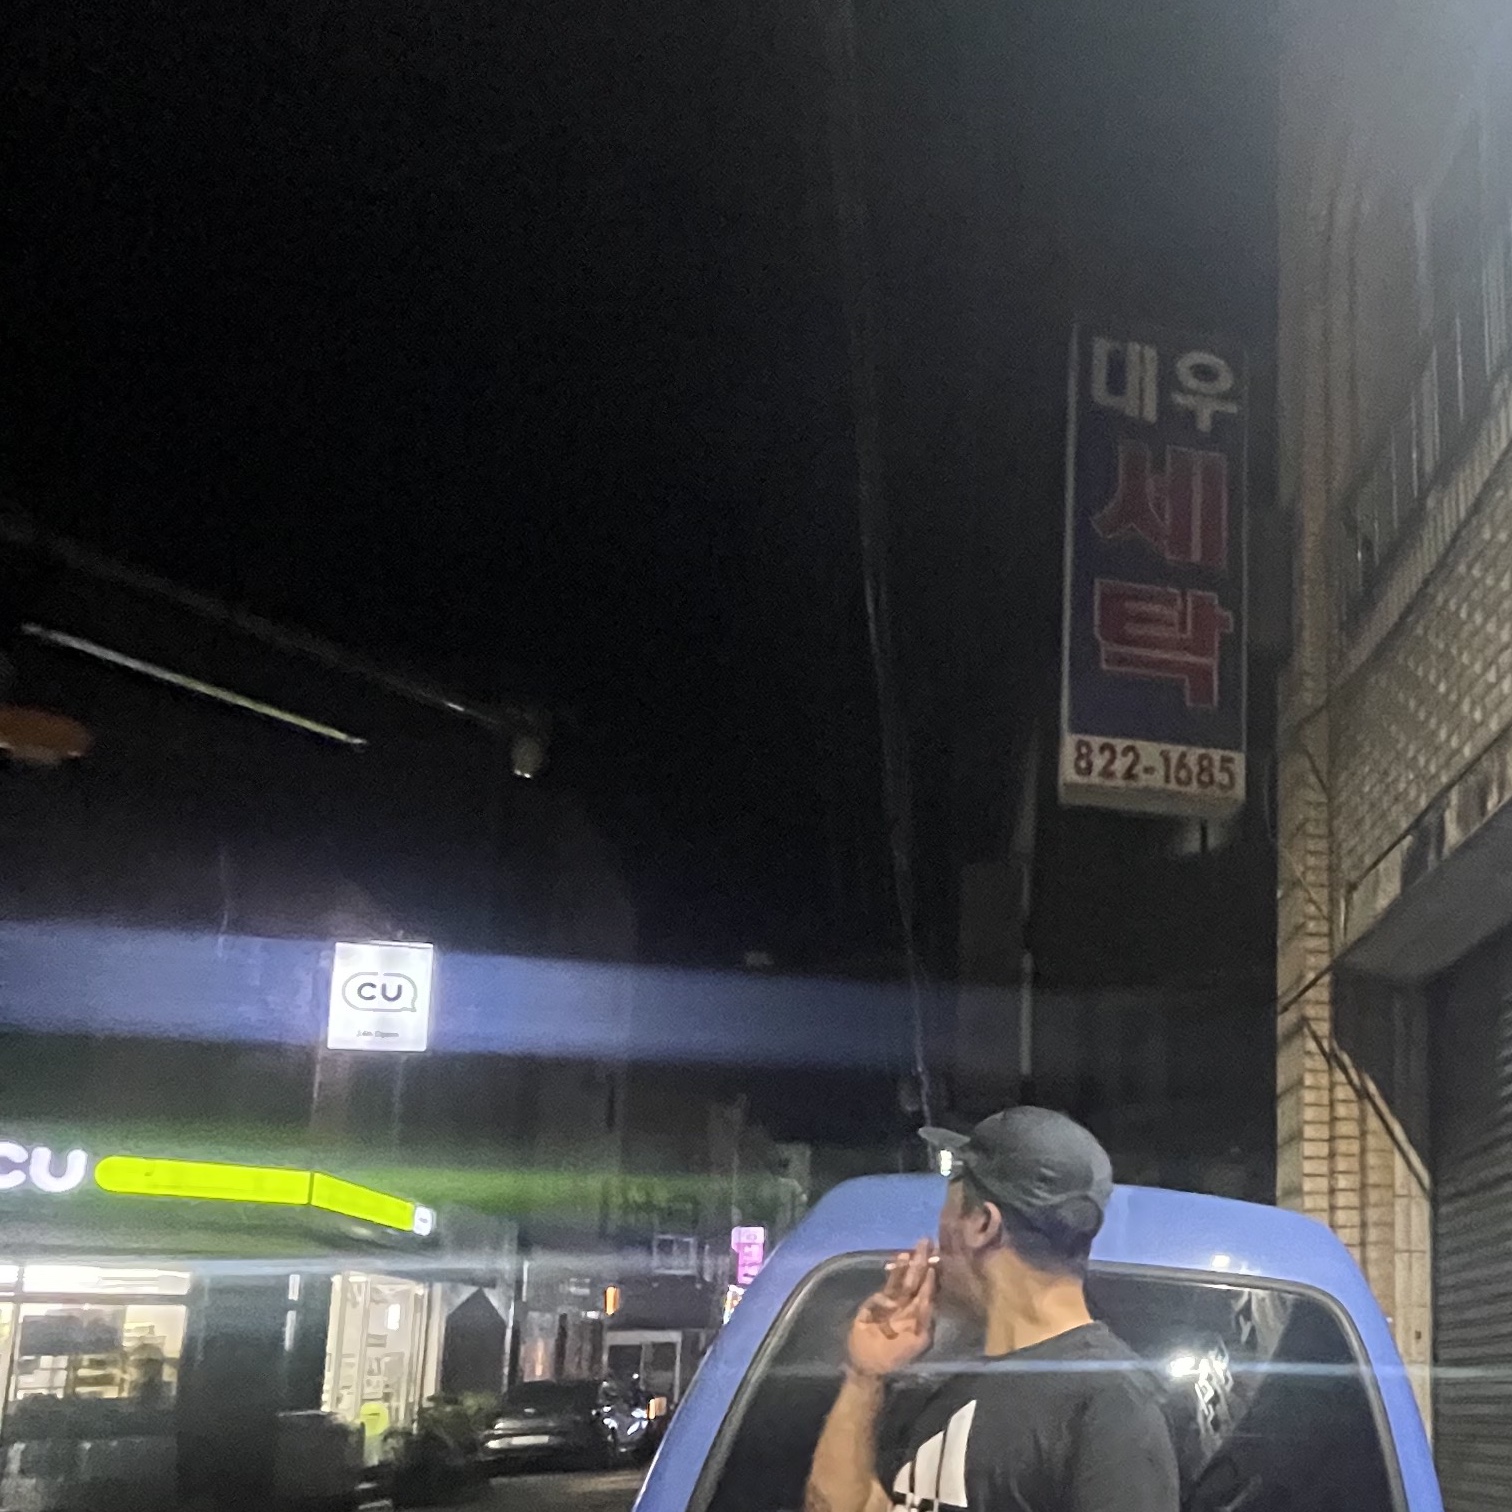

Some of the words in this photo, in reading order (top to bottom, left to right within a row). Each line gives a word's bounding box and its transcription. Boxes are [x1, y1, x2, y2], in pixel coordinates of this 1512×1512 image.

[1074, 738, 1237, 792] 822-1685
[357, 982, 403, 1002] CU
[0, 1141, 88, 1193] CU
